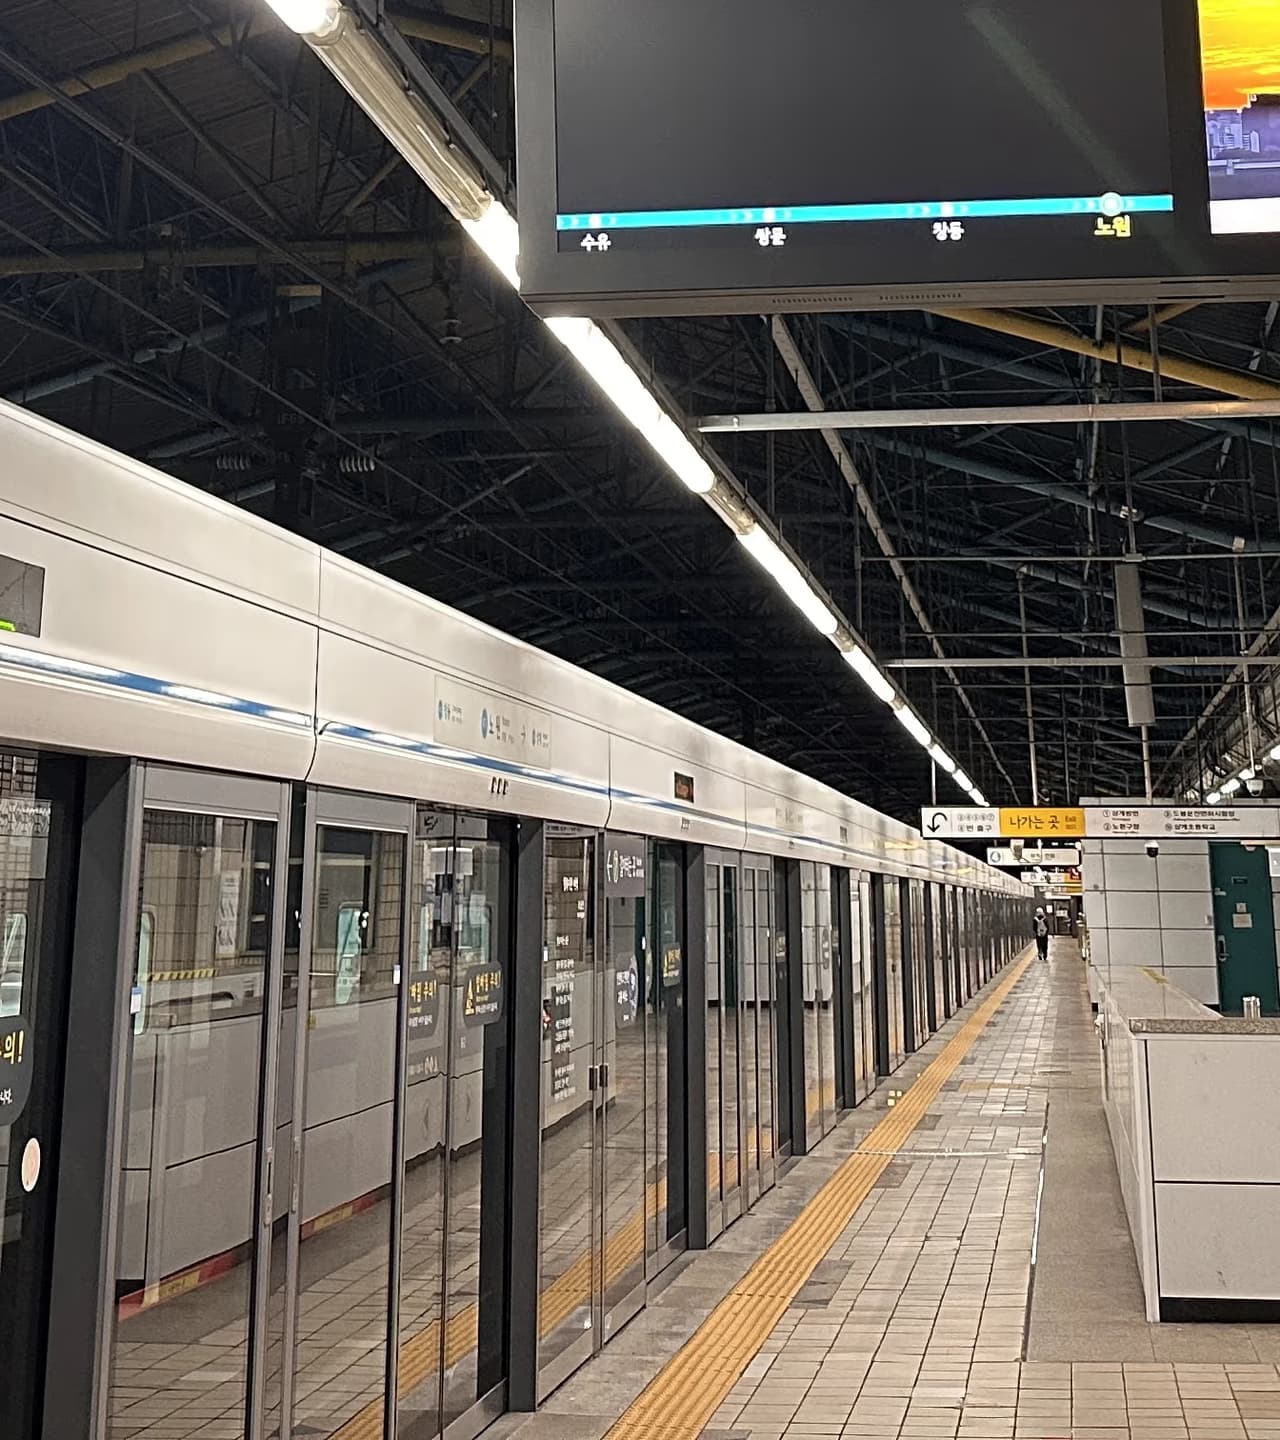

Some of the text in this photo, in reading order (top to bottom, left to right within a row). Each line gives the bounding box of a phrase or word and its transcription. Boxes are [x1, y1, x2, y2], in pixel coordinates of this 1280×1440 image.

[754, 226, 787, 247] 쌍문
[932, 220, 965, 241] 창동
[1093, 214, 1132, 238] 노원
[580, 232, 612, 252] 수유
[1009, 814, 1044, 830] 나가는
[1048, 814, 1060, 830] 곳
